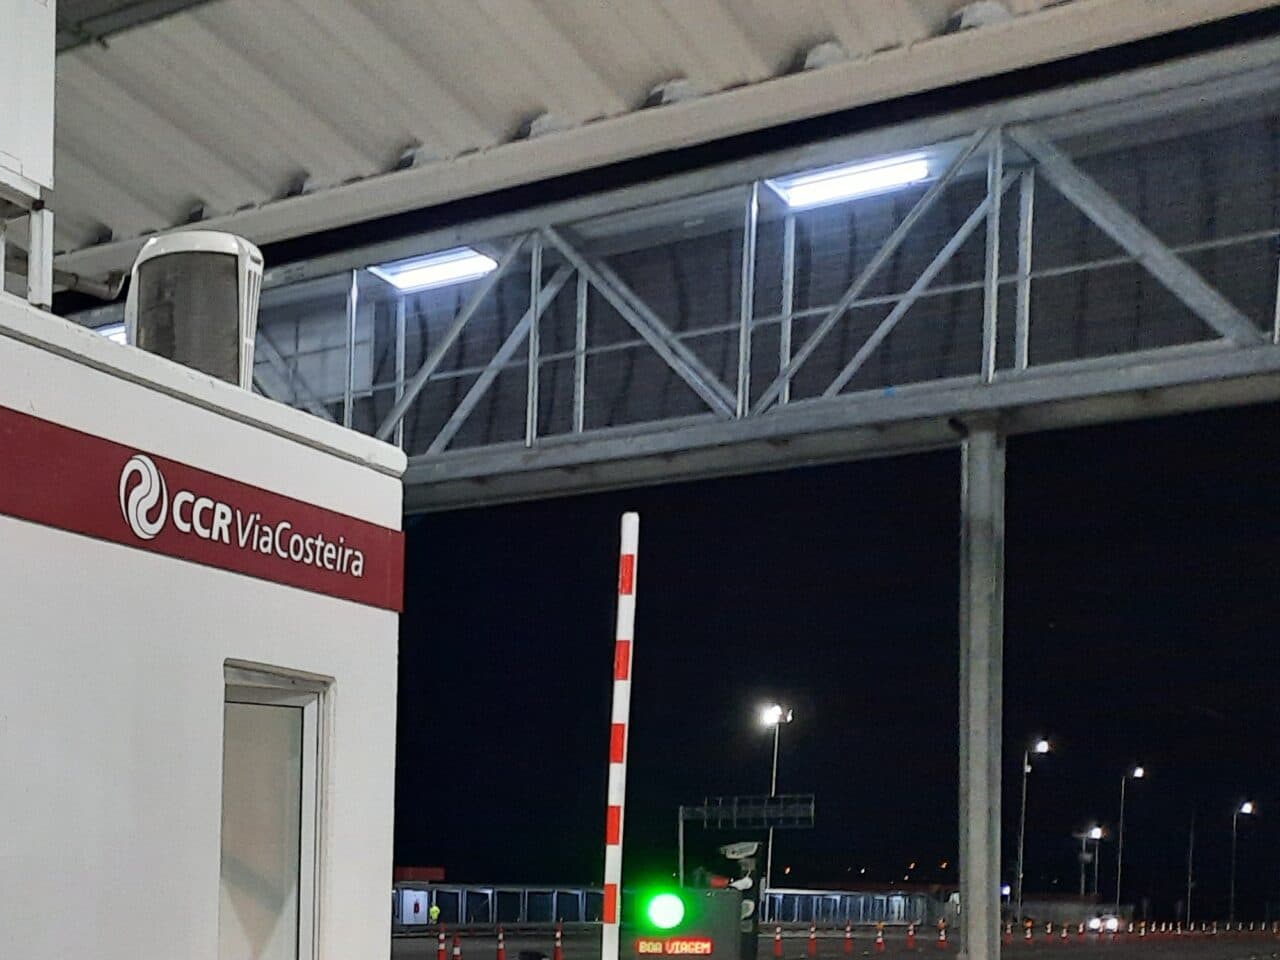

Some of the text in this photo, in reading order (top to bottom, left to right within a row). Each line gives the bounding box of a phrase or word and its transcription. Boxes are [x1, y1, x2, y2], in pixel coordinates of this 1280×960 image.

[172, 490, 364, 577] CCR ViaCosteira
[638, 941, 711, 954] BOA VIAGEM
